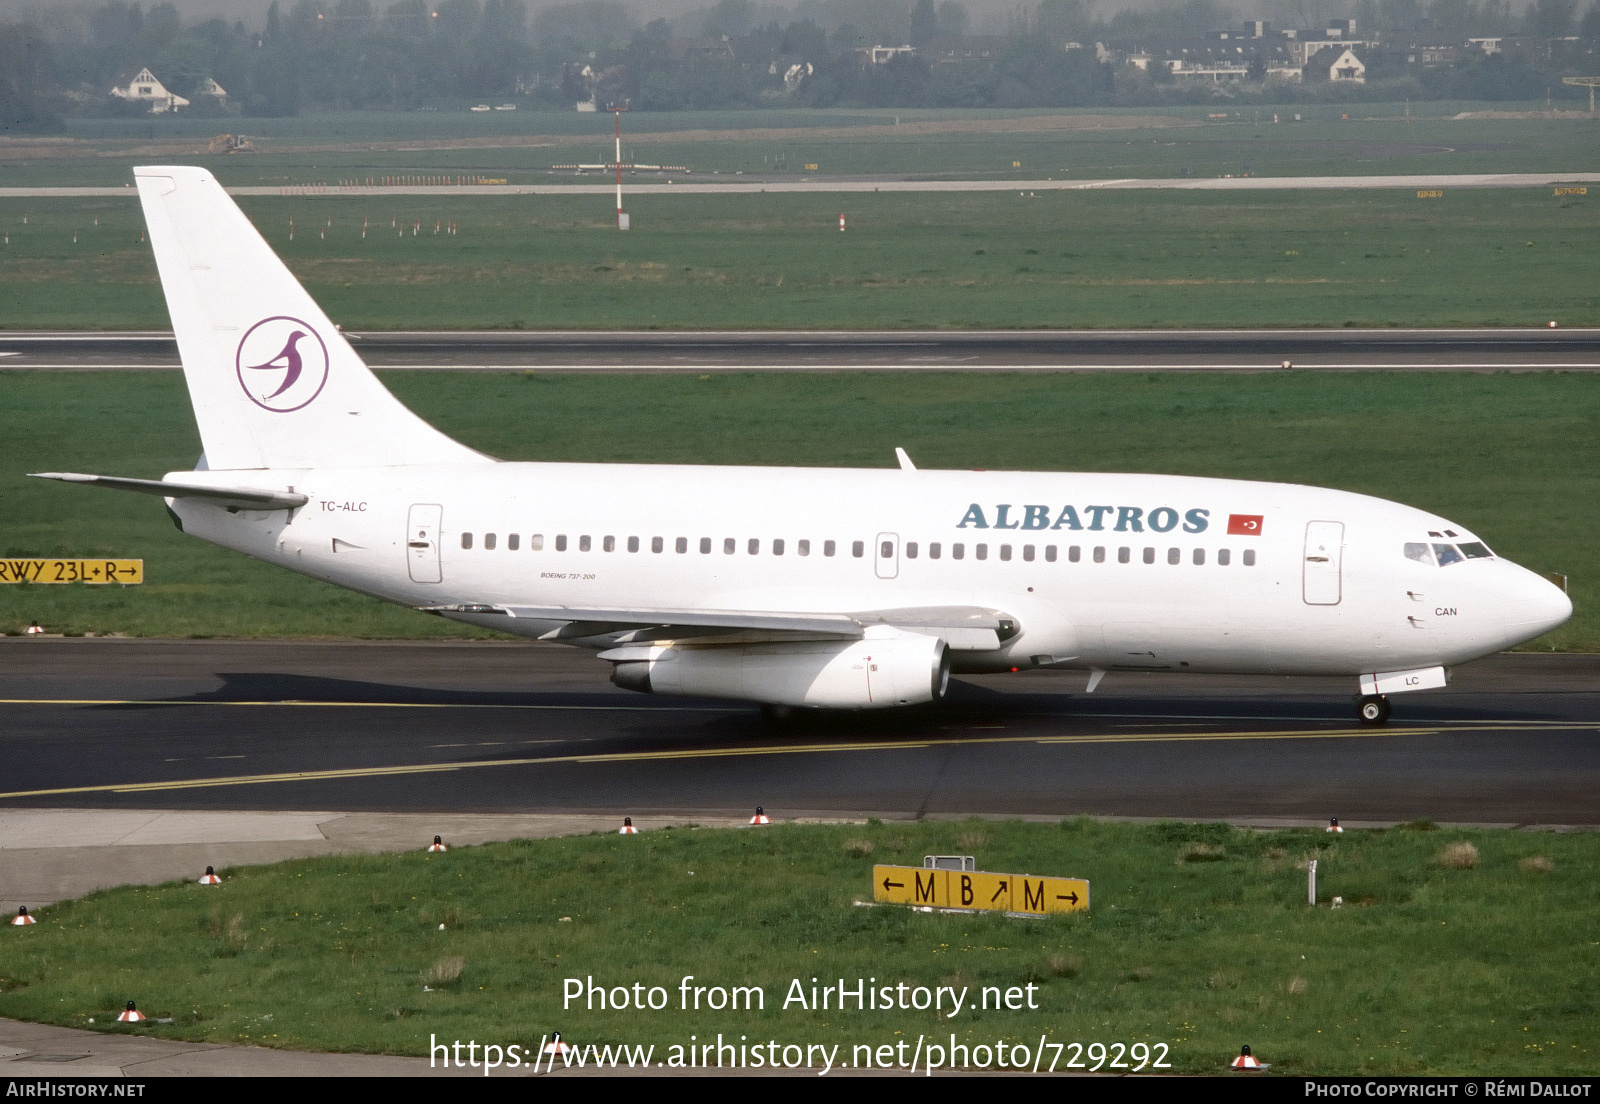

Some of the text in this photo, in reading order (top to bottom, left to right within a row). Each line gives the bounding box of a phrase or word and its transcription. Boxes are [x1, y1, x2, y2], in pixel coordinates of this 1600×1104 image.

[320, 501, 368, 512] TC-ALC
[957, 504, 1210, 533] ALBATROS
[0, 561, 46, 581] RWY
[540, 572, 567, 580] BOEING
[1435, 607, 1458, 616] CAN
[1405, 676, 1420, 686] LC
[915, 871, 1045, 911] M B M
